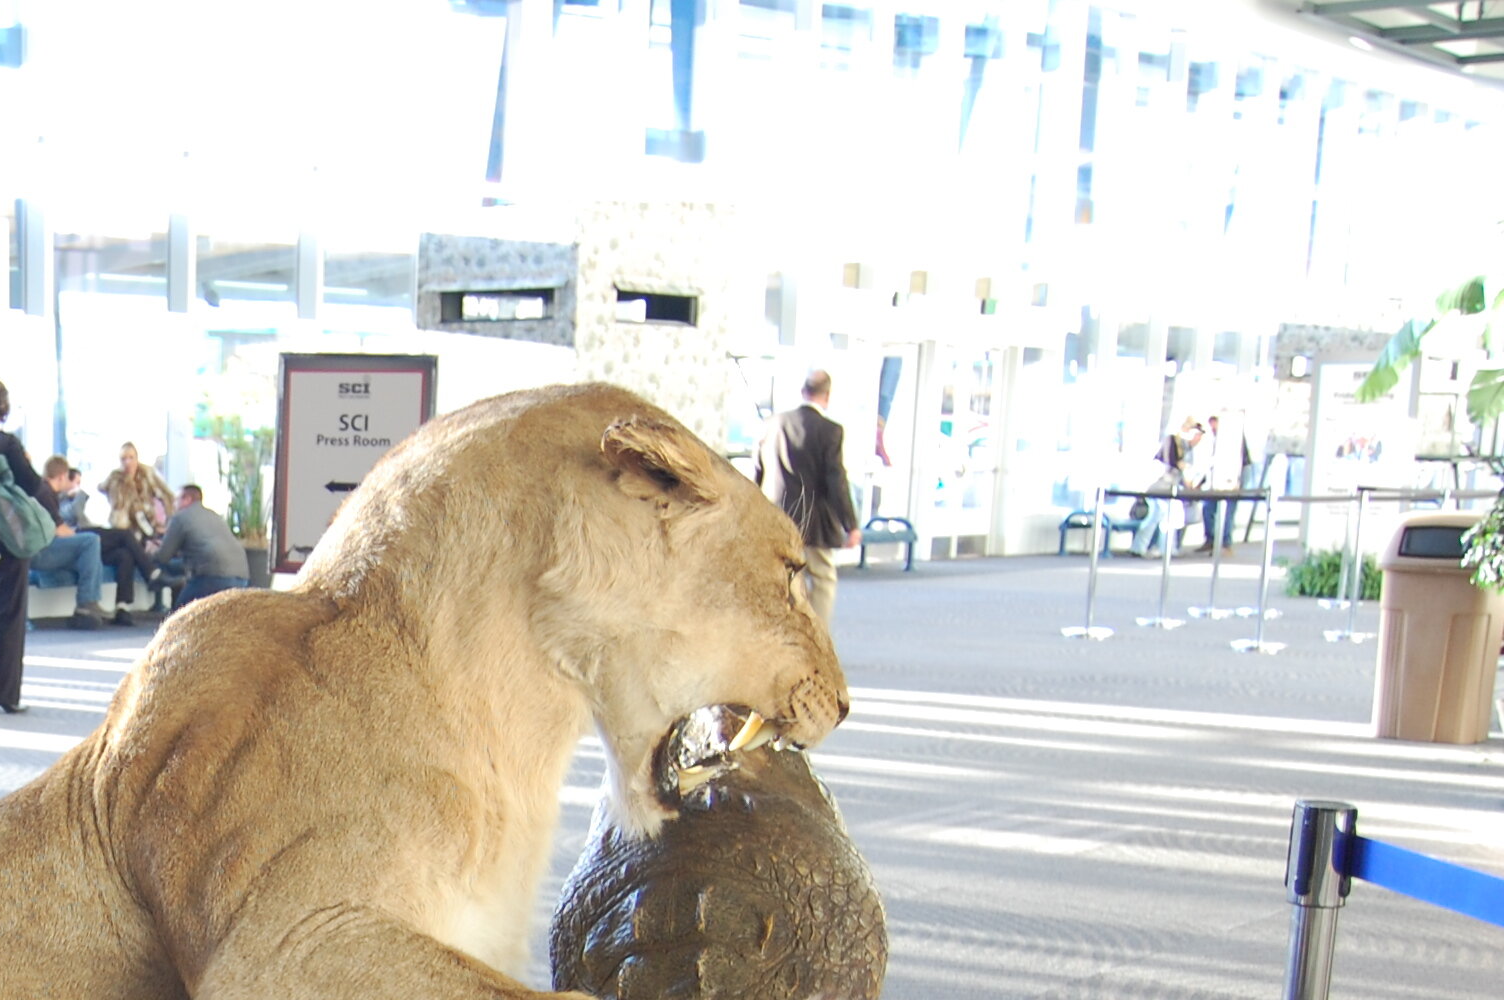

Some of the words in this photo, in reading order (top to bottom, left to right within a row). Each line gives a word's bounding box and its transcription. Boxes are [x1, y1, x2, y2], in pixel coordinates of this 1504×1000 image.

[339, 383, 370, 394] SCI
[339, 414, 369, 431] SCI
[316, 434, 350, 446] Press
[353, 435, 391, 446] Room
